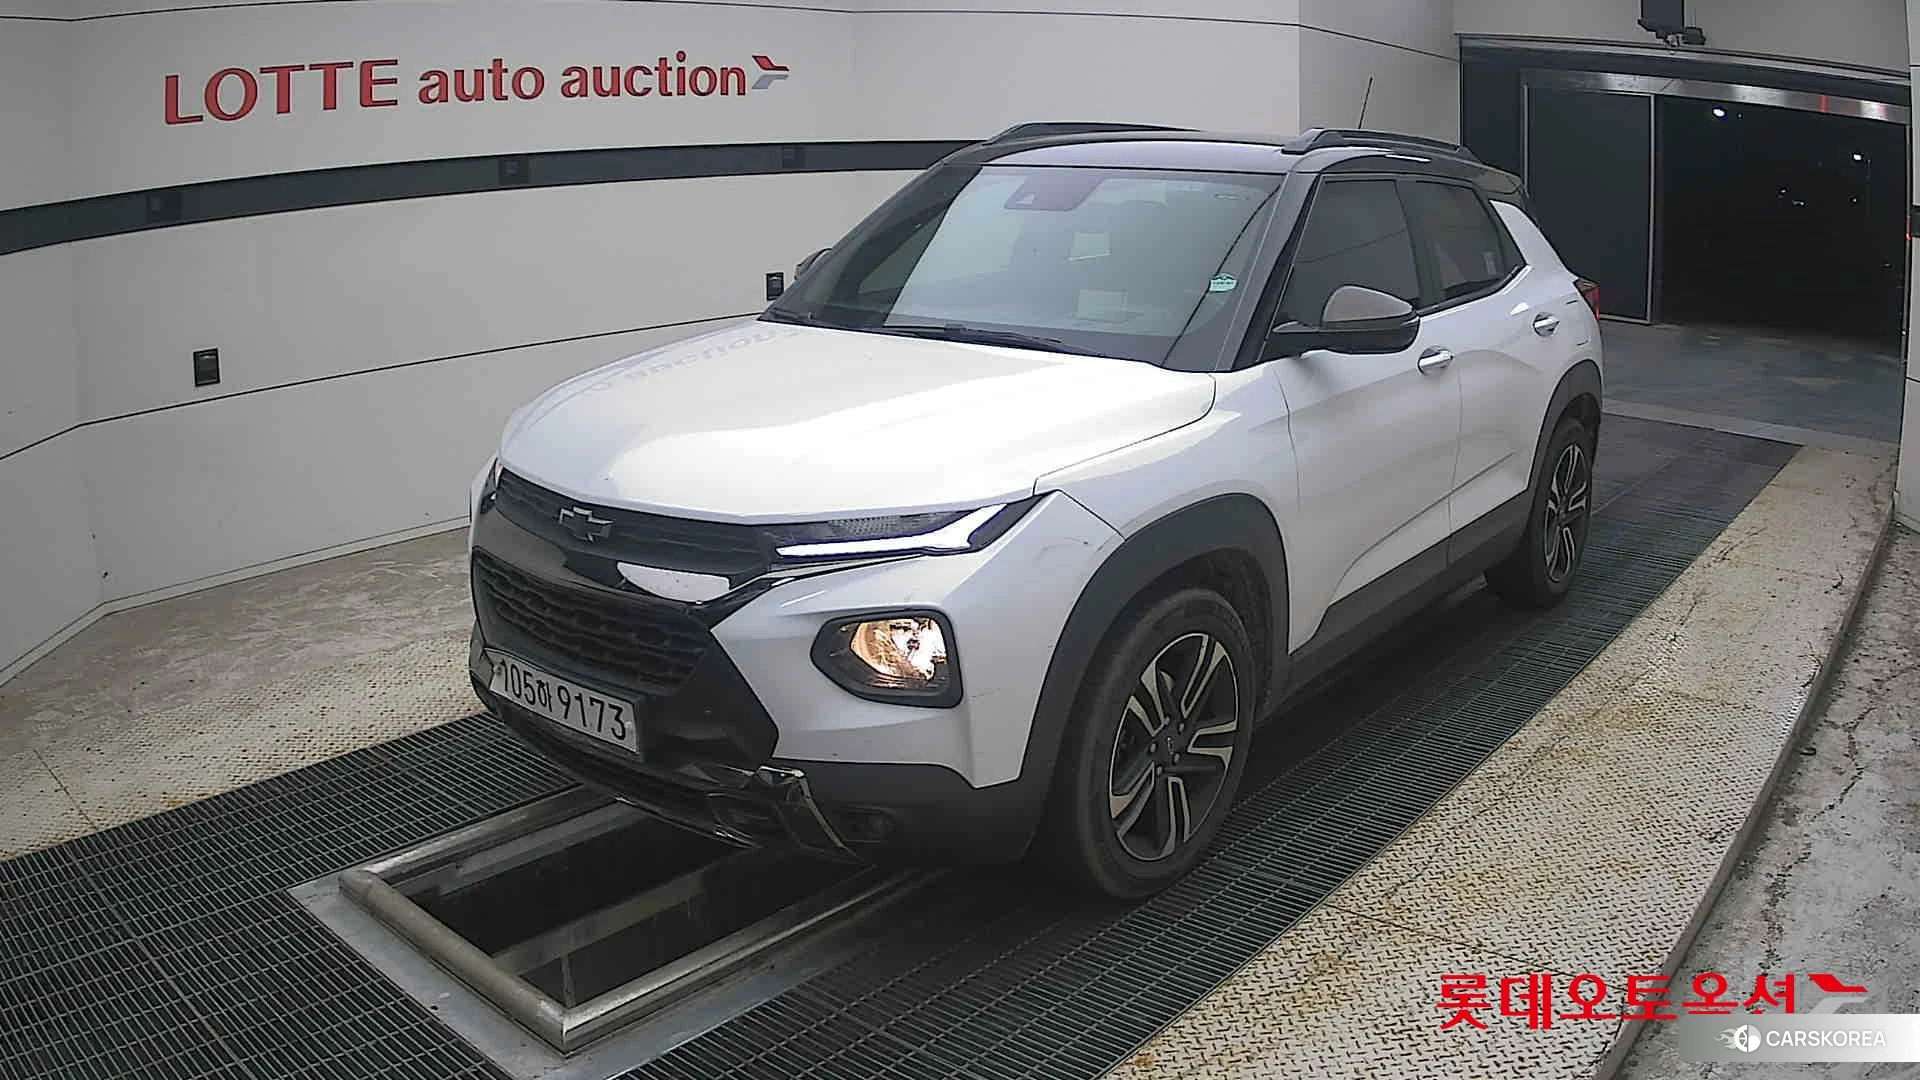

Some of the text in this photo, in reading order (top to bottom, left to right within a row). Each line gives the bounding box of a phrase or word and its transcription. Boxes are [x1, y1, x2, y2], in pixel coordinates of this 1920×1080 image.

[164, 50, 748, 126] LOTTE auto auction
[557, 685, 627, 740] 9173
